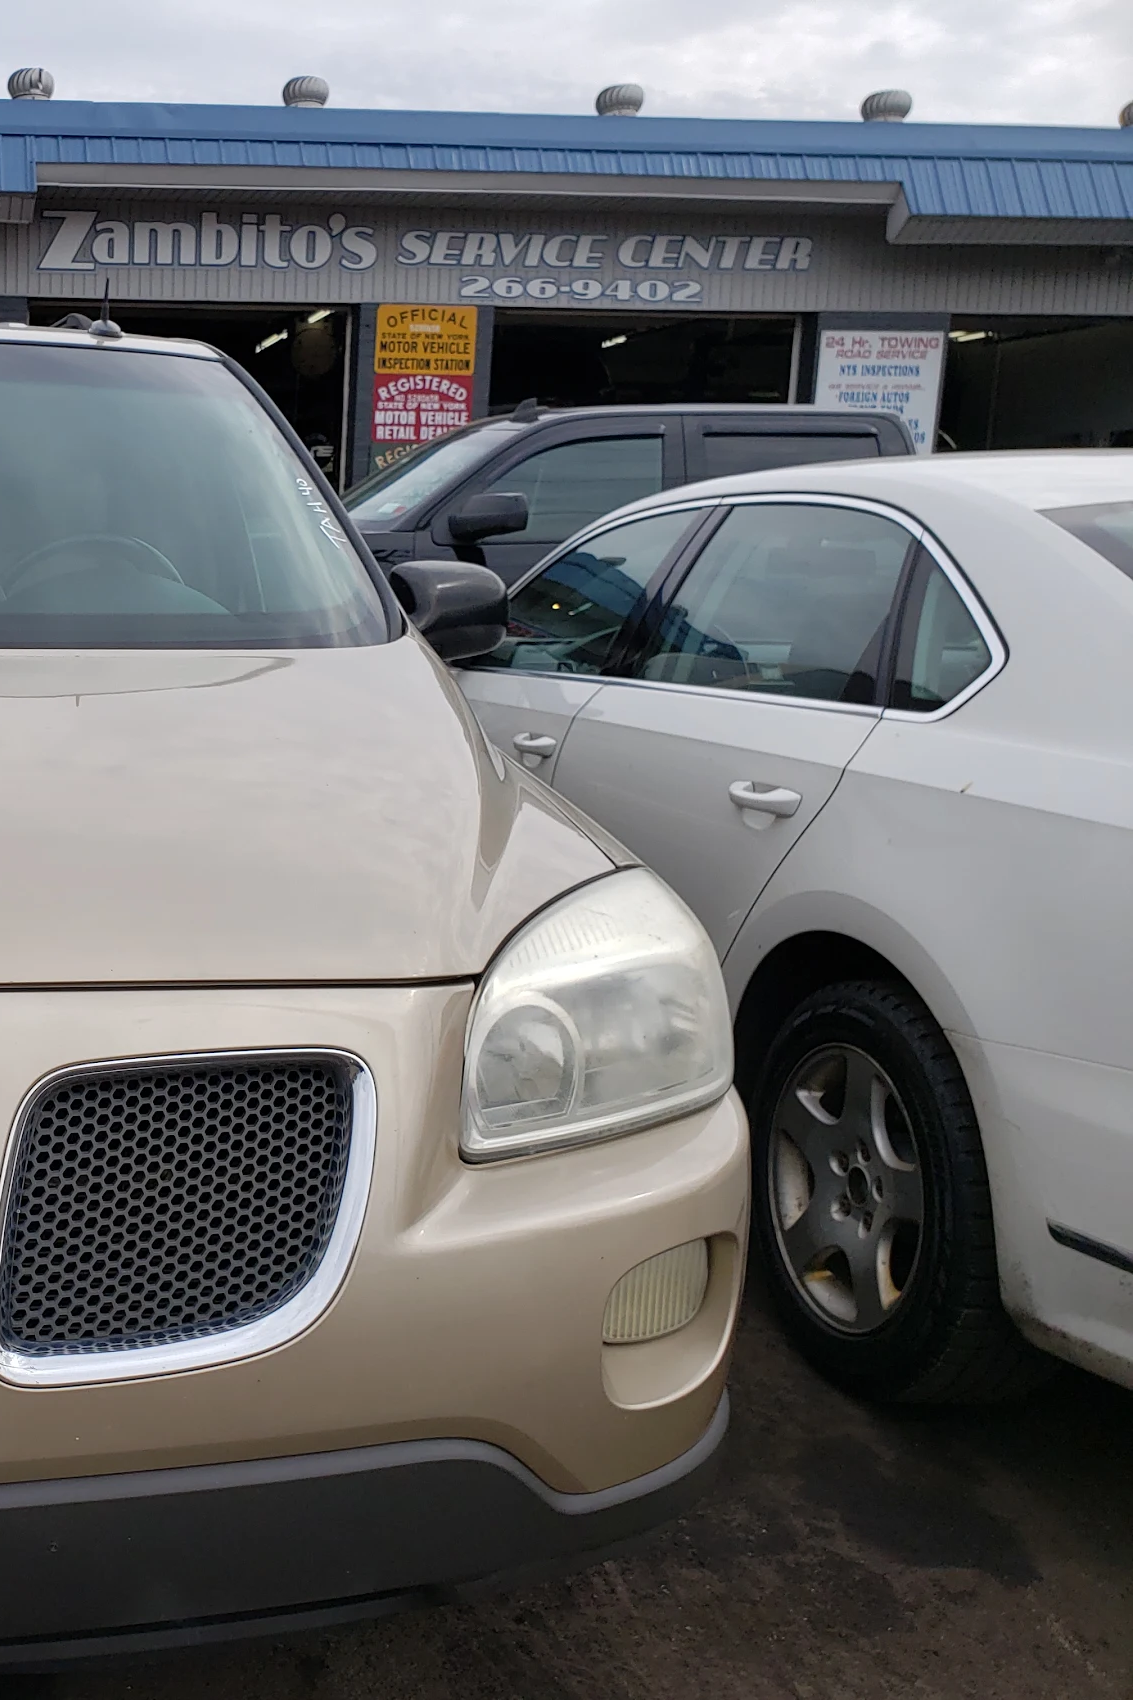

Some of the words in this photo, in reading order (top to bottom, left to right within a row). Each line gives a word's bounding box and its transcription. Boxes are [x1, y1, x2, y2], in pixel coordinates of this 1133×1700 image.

[37, 210, 378, 271] Zambito's
[396, 230, 609, 269] SERVICE
[618, 234, 814, 271] CENTER
[459, 275, 703, 302] 266-9402
[387, 308, 468, 329] OFFICIAL
[381, 332, 407, 340] STATE
[825, 336, 845, 348] 24
[878, 336, 940, 349] TOWING
[379, 340, 418, 353] MOTOR
[422, 341, 471, 355] VEHICLE
[835, 349, 871, 360] ROAD
[875, 350, 929, 360] SERVICE
[378, 357, 431, 371] INSPECTION
[433, 358, 471, 371] STATION
[839, 364, 857, 377] NYS
[861, 364, 920, 377] INSPECTIONS
[377, 375, 468, 401] REGISTERED
[838, 391, 877, 403] FOREIGN
[881, 391, 910, 404] AUTOS
[377, 401, 404, 410] STATE
[406, 402, 419, 410] OF
[420, 402, 440, 410] NEW
[442, 402, 467, 411] YORK
[374, 411, 416, 425] MOTOR
[420, 411, 470, 426] VEHICLE
[375, 426, 417, 440] RETAIL
